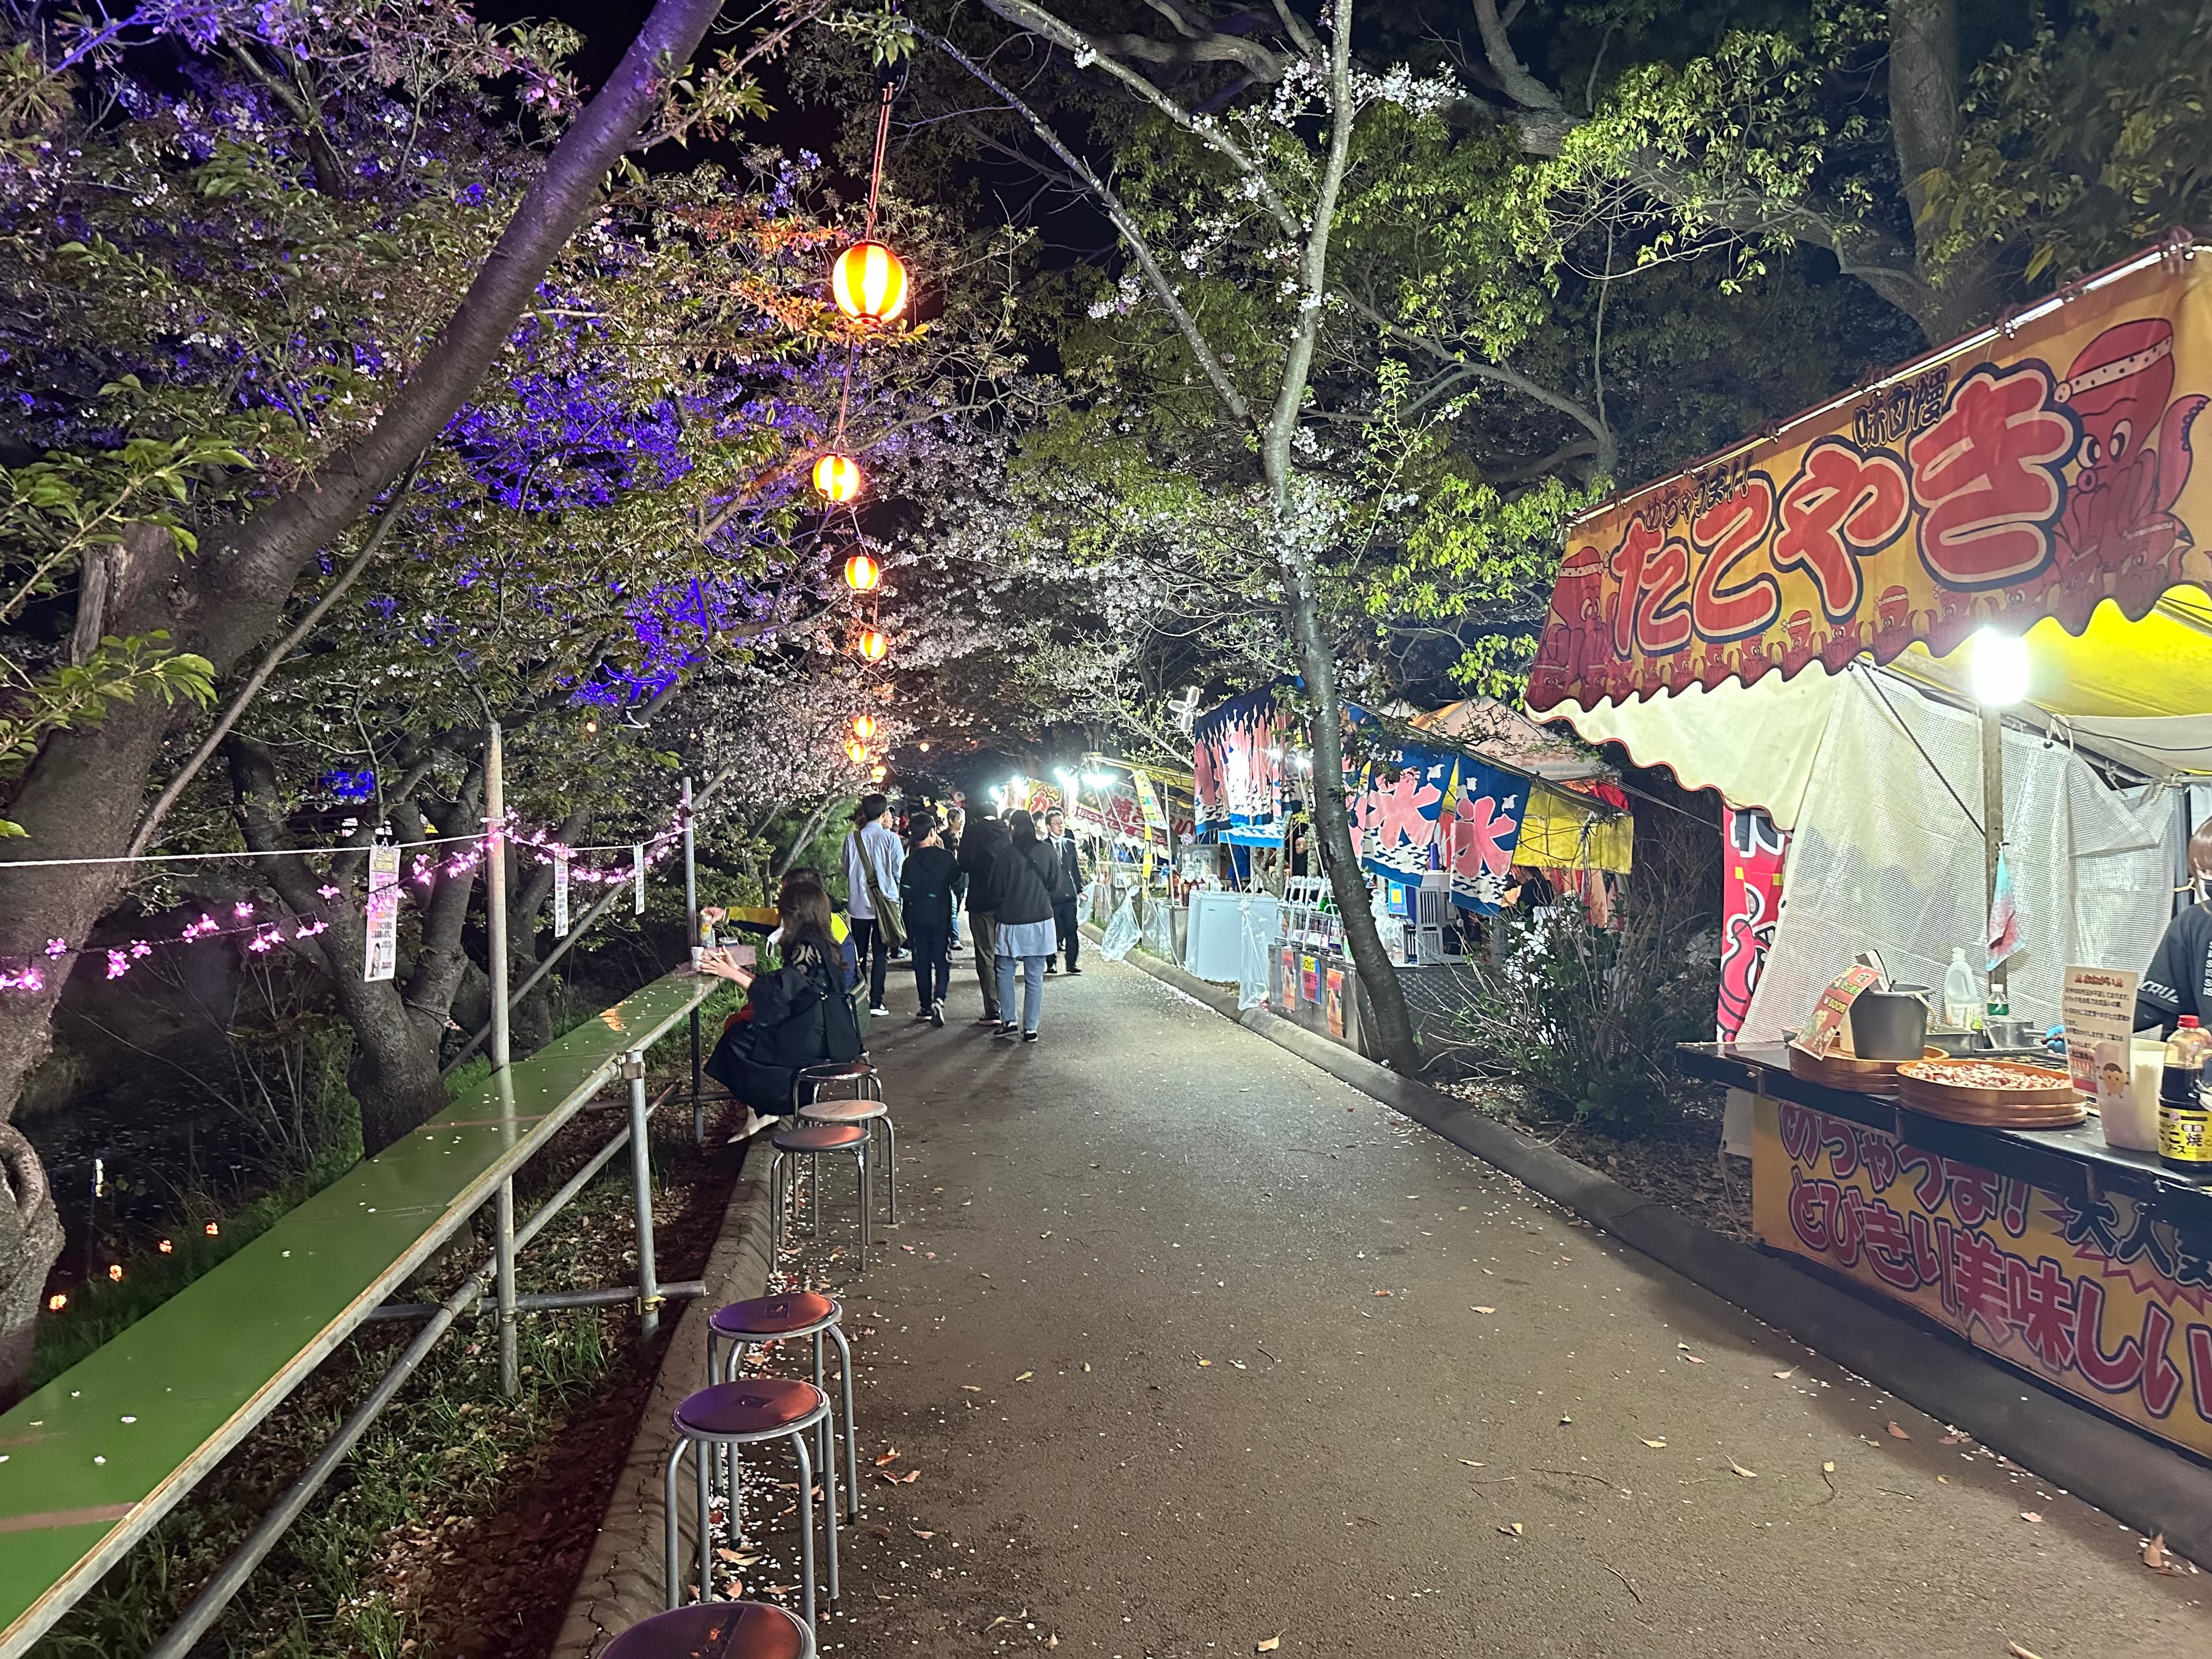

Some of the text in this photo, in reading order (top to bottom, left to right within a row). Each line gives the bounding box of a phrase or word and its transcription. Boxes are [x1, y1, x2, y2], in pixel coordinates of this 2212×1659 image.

[1611, 362, 2082, 657] たこやき
[1365, 767, 1441, 849] 氷
[1453, 796, 1517, 878] 氷
[1789, 1164, 2212, 1420] とびきり美味しい
